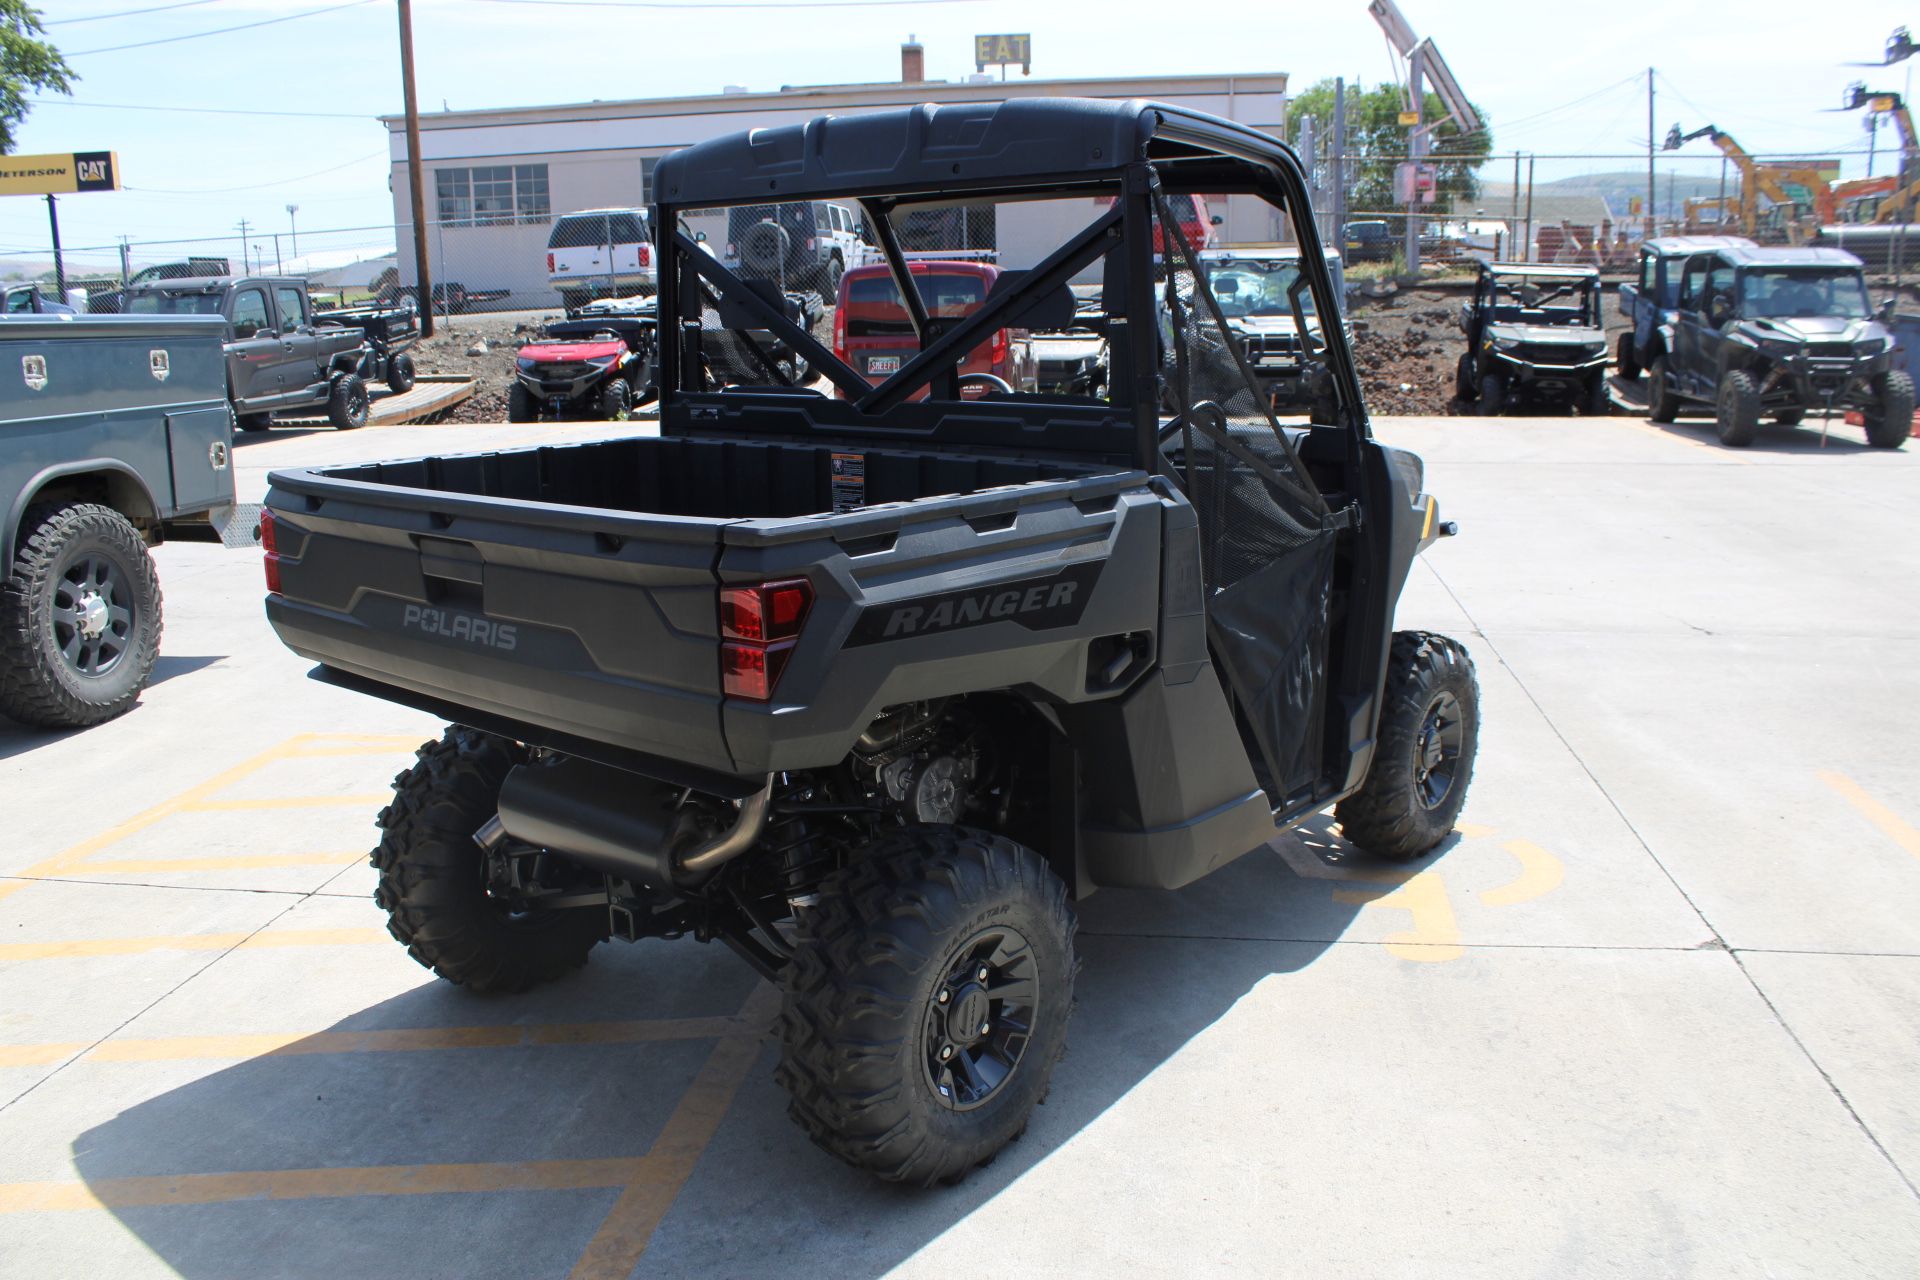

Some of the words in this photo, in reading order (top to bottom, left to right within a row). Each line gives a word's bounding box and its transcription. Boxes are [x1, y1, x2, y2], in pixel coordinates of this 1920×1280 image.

[978, 36, 1027, 61] EAT
[78, 160, 106, 182] CAT
[882, 580, 1079, 637] RANGER
[403, 604, 517, 650] POLARIS
